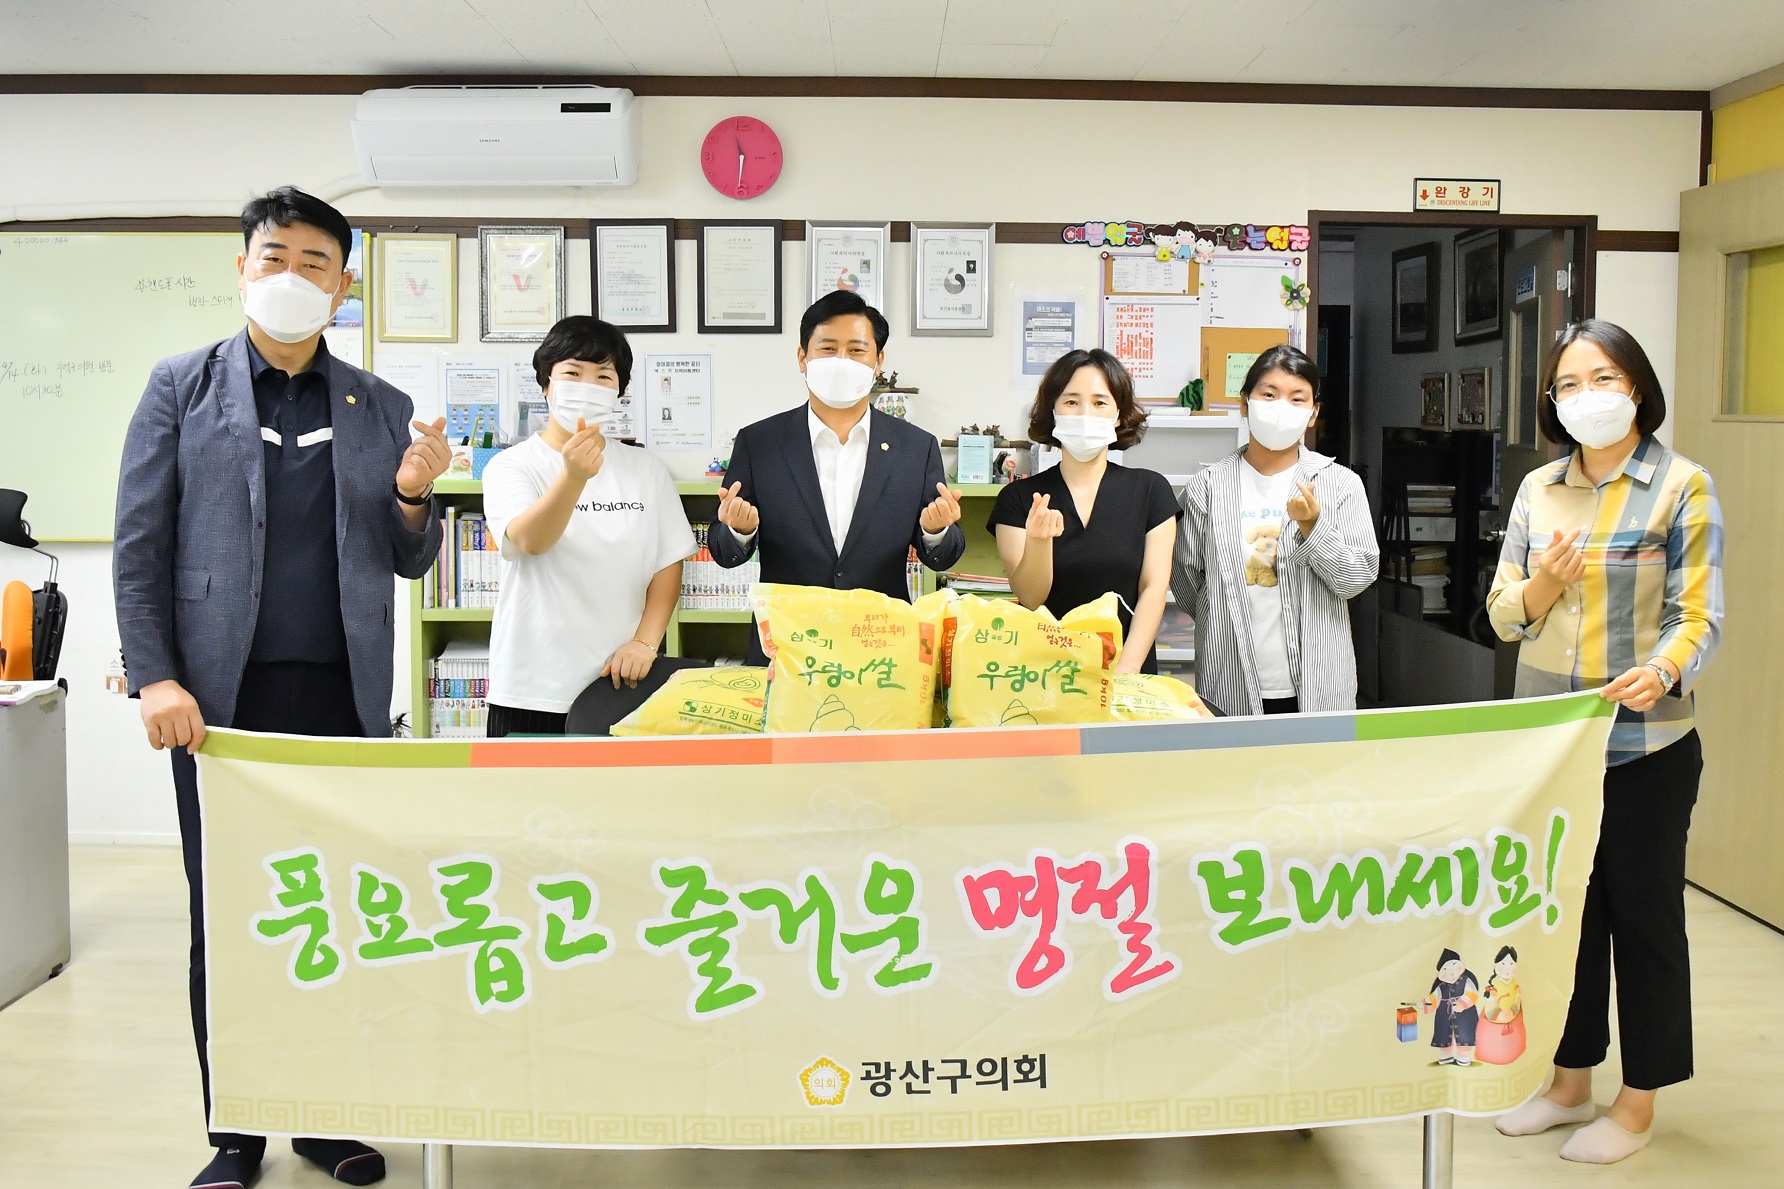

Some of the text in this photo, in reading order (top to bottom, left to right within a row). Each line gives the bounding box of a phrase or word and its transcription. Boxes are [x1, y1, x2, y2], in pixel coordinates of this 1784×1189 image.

[1260, 508, 1283, 519] pu
[863, 613, 889, 624] 우리가
[797, 656, 906, 691] 우렁이쌀
[977, 659, 1088, 696] 우렁이쌀
[1100, 678, 1110, 708] 10kg
[1112, 695, 1170, 708] 기정미소
[257, 815, 1565, 1013] 풍요롭고 즐거운 명절 보내세요!
[814, 1077, 837, 1090] 의회
[860, 1053, 1047, 1097] 광산구의회
